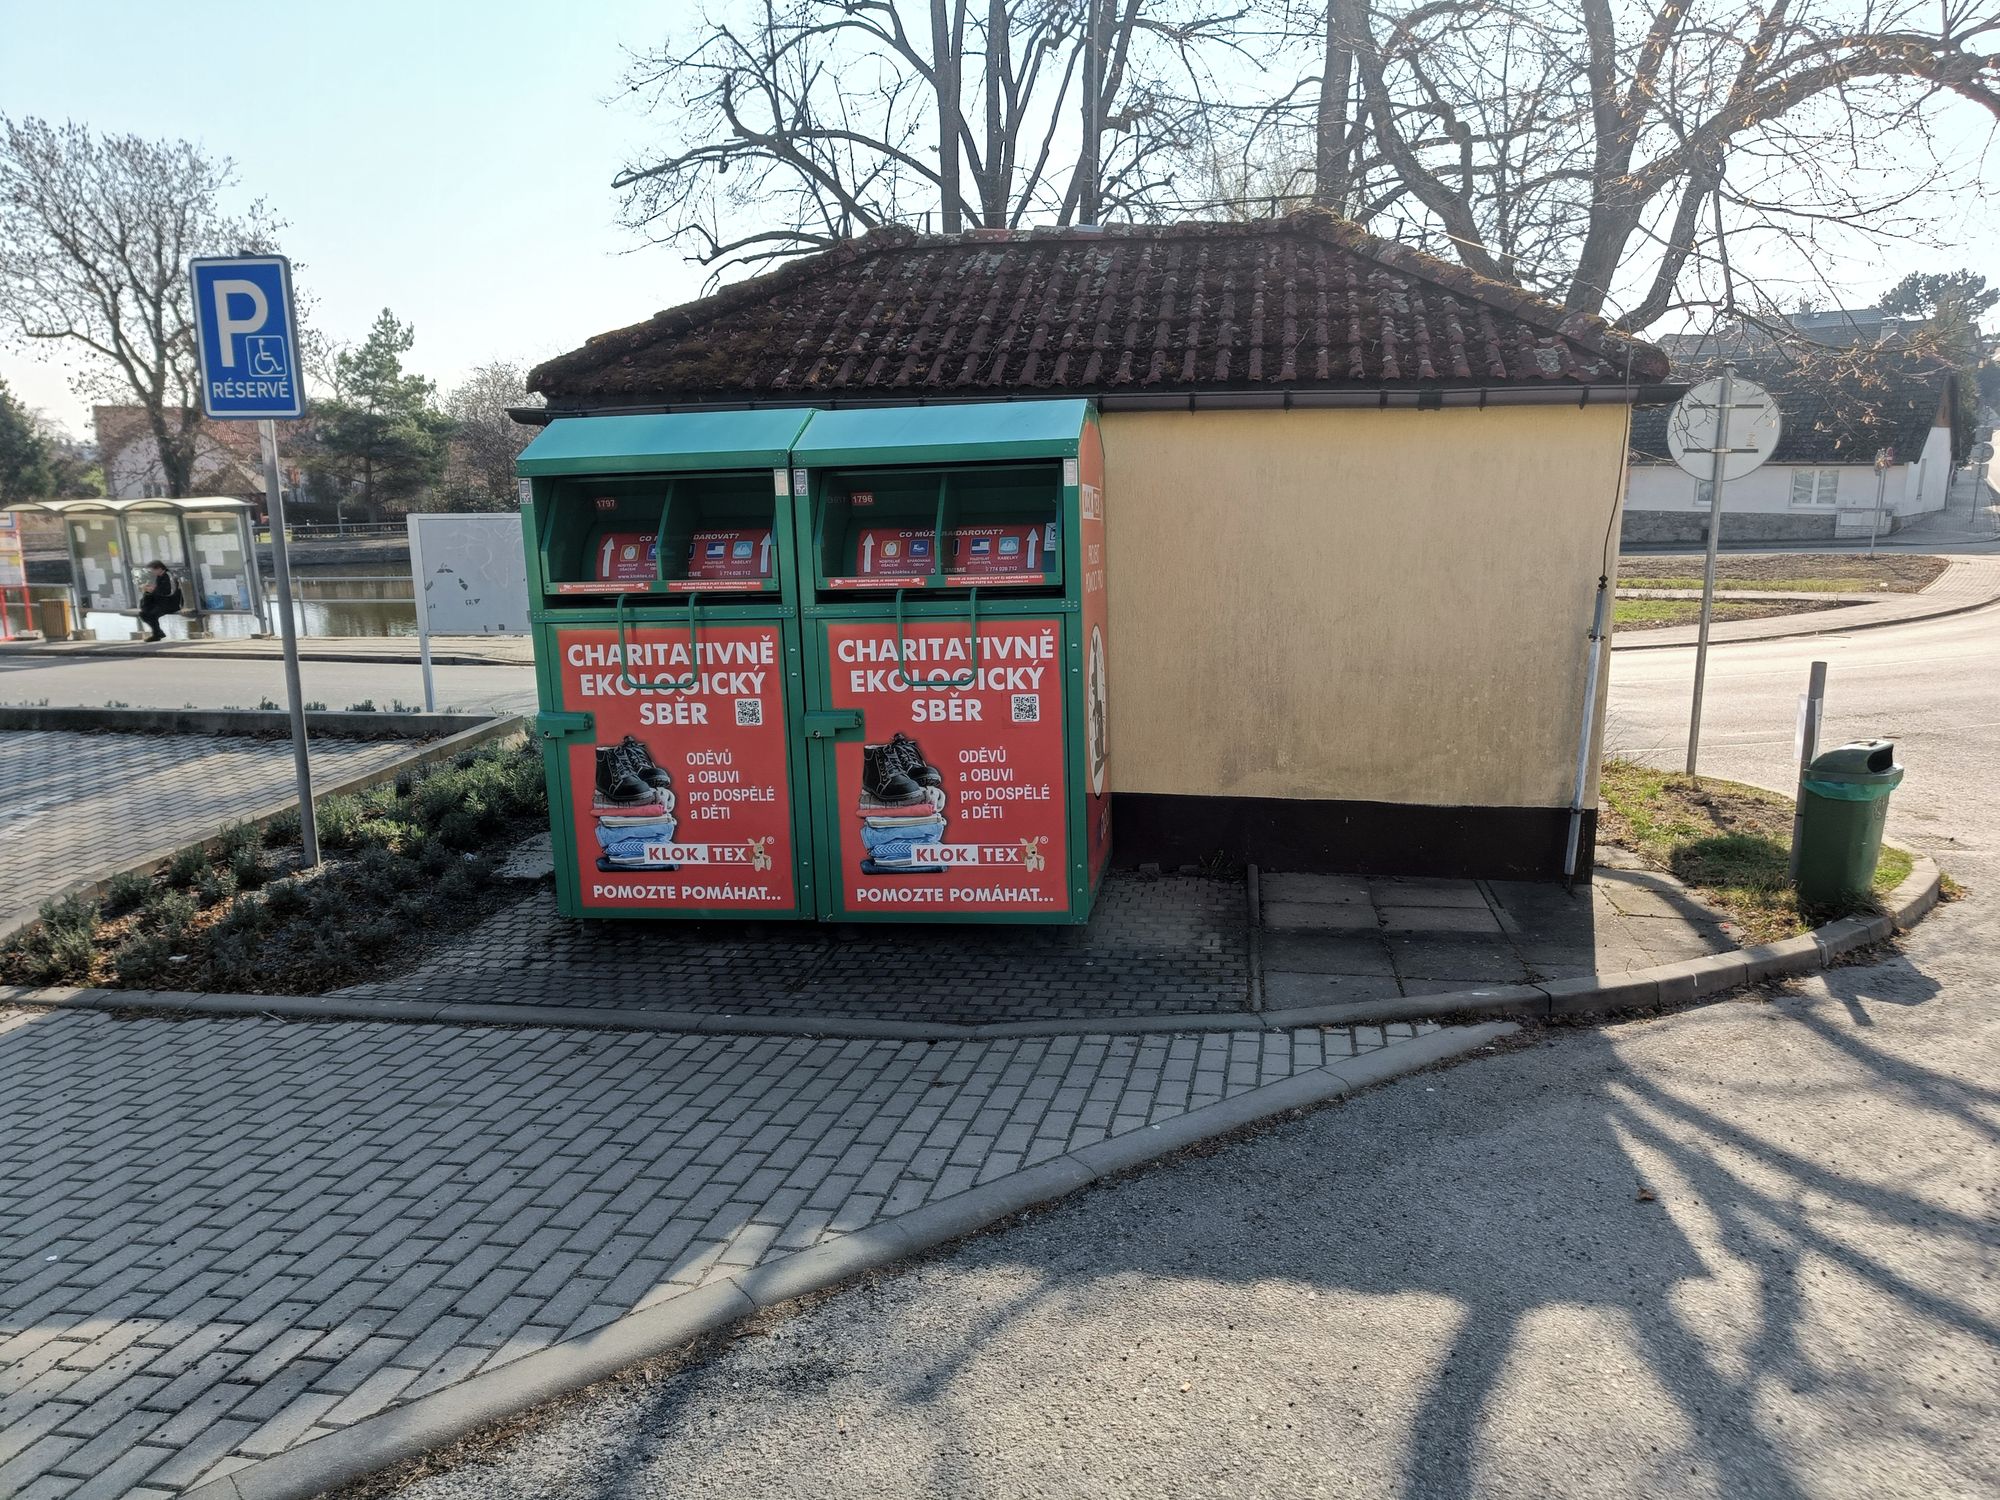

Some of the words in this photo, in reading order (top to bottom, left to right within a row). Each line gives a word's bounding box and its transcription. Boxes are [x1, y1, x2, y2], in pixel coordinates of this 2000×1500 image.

[213, 280, 268, 367] P
[212, 377, 290, 398] RÉSERVÉ
[596, 499, 615, 508] 1797
[852, 495, 873, 503] 1796
[567, 634, 774, 667] CHARITATIVNĚ
[837, 628, 1054, 663] CHARITATIVNĚ
[580, 665, 766, 696] EKOLOGICKÝ
[850, 660, 1045, 693] EKOLOGICKÝ
[639, 696, 708, 725] SBĚR
[911, 692, 983, 723] SBĚR
[686, 749, 732, 766] ODĚVŮ
[958, 746, 1006, 763] ODĚVŮ
[687, 772, 695, 783] a
[698, 770, 740, 784] OBUVI
[959, 771, 967, 782] a
[970, 768, 1013, 782] OBUVI
[689, 790, 710, 804] pro
[713, 785, 775, 802] DOSPĚLÉ
[960, 789, 982, 803] pro
[985, 783, 1050, 800] DOSPĚLÉ
[690, 809, 698, 820] a
[701, 804, 730, 820] DĚTI
[961, 808, 969, 819] a
[972, 803, 1003, 819] DĚTI
[712, 847, 747, 862] TEX
[983, 848, 1019, 862] TEX
[593, 885, 676, 900] POMOZTE
[681, 882, 782, 901] POMÁHAT...
[856, 888, 944, 902] POMOZTE
[949, 883, 1054, 902] POMÁHAT...
